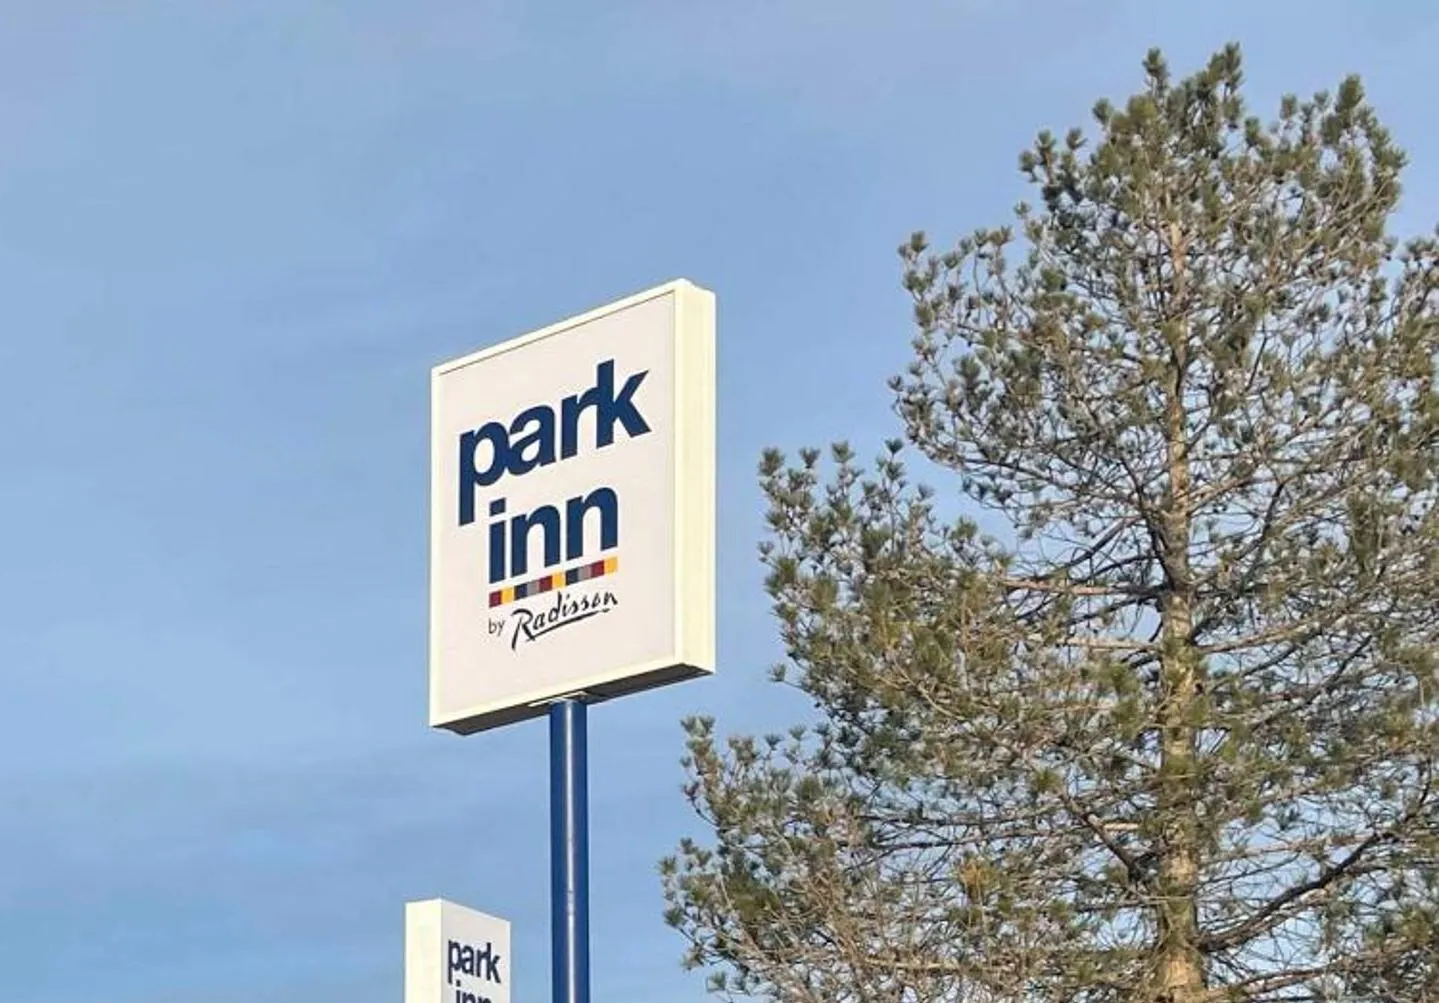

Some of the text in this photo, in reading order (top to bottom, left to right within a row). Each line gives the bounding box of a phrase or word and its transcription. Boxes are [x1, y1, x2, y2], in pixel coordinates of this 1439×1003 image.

[459, 358, 652, 527] park
[489, 486, 618, 584] inn
[488, 592, 619, 651] by Radisson
[448, 939, 501, 985] park
